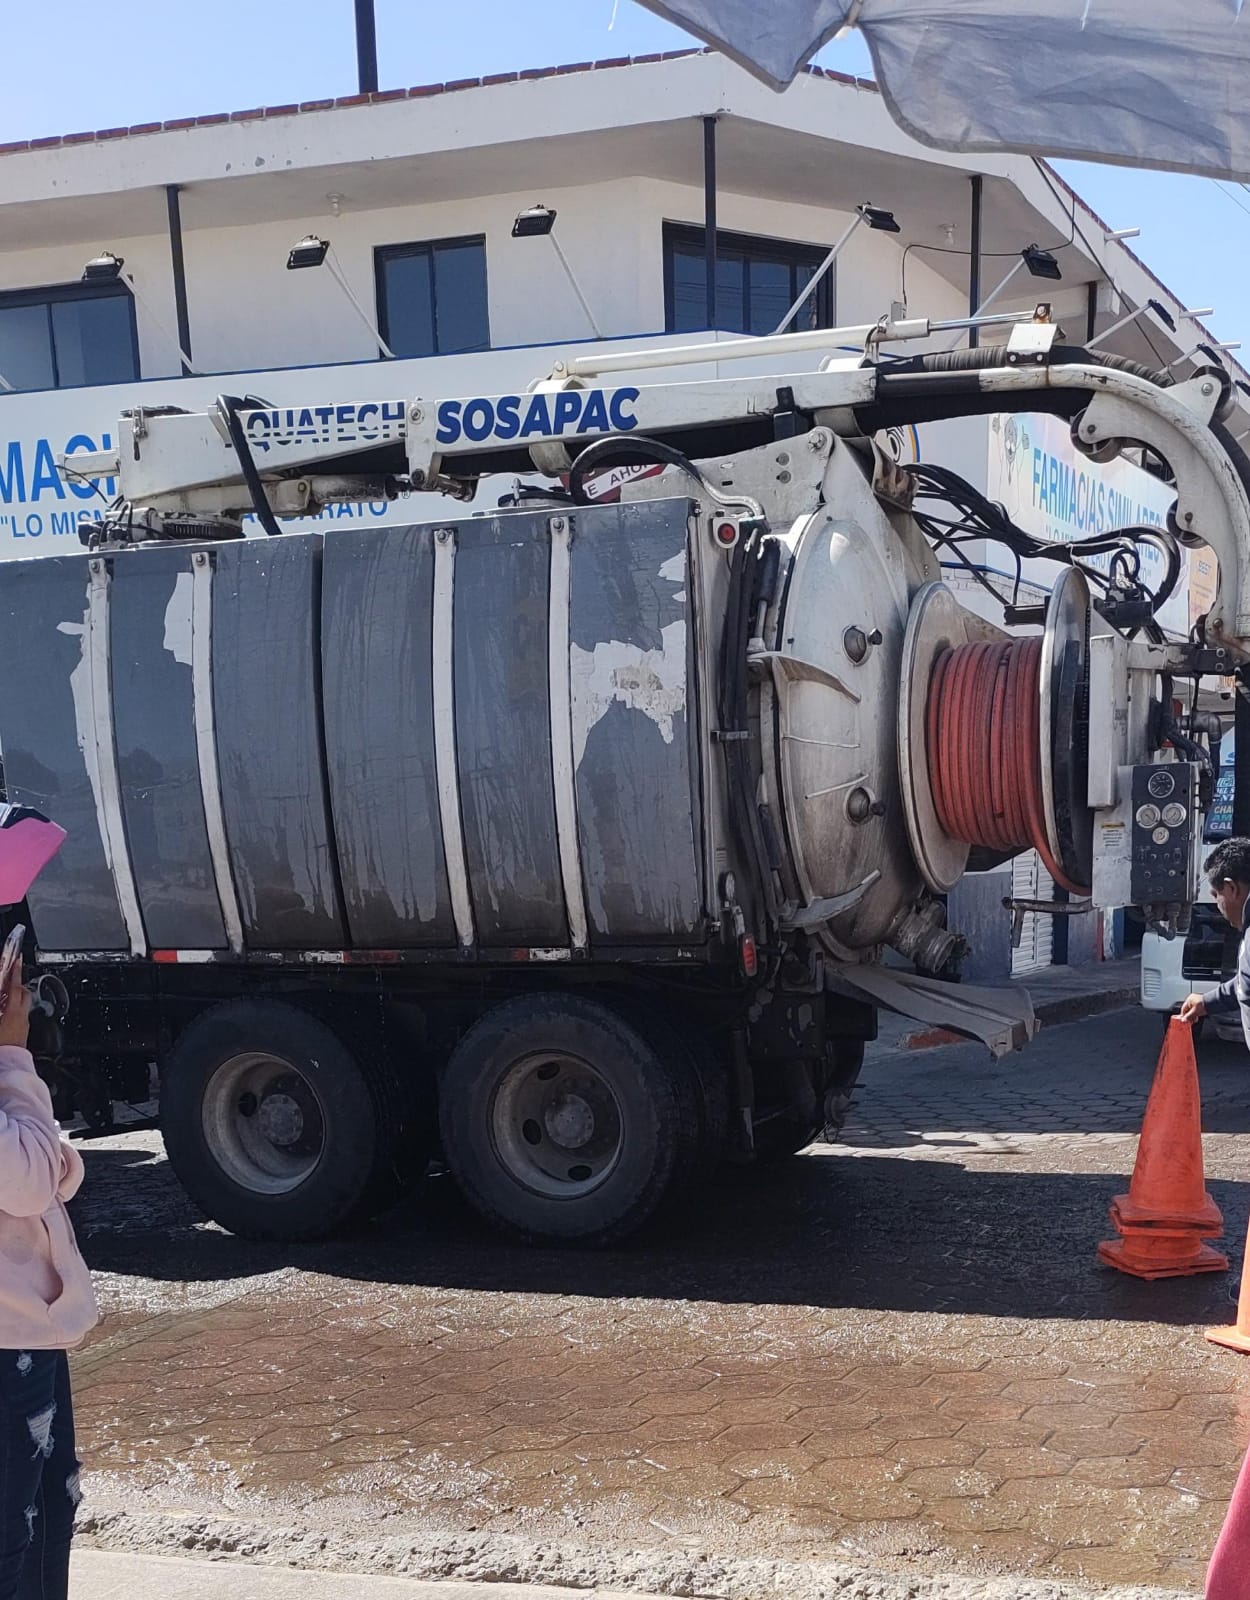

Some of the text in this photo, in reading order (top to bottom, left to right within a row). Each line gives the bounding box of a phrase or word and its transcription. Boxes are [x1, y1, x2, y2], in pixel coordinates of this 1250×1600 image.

[225, 401, 406, 453] QUATECH
[436, 387, 640, 444] SOSAPAC
[611, 464, 647, 485] AHO
[1032, 447, 1104, 533] FARMACIAS
